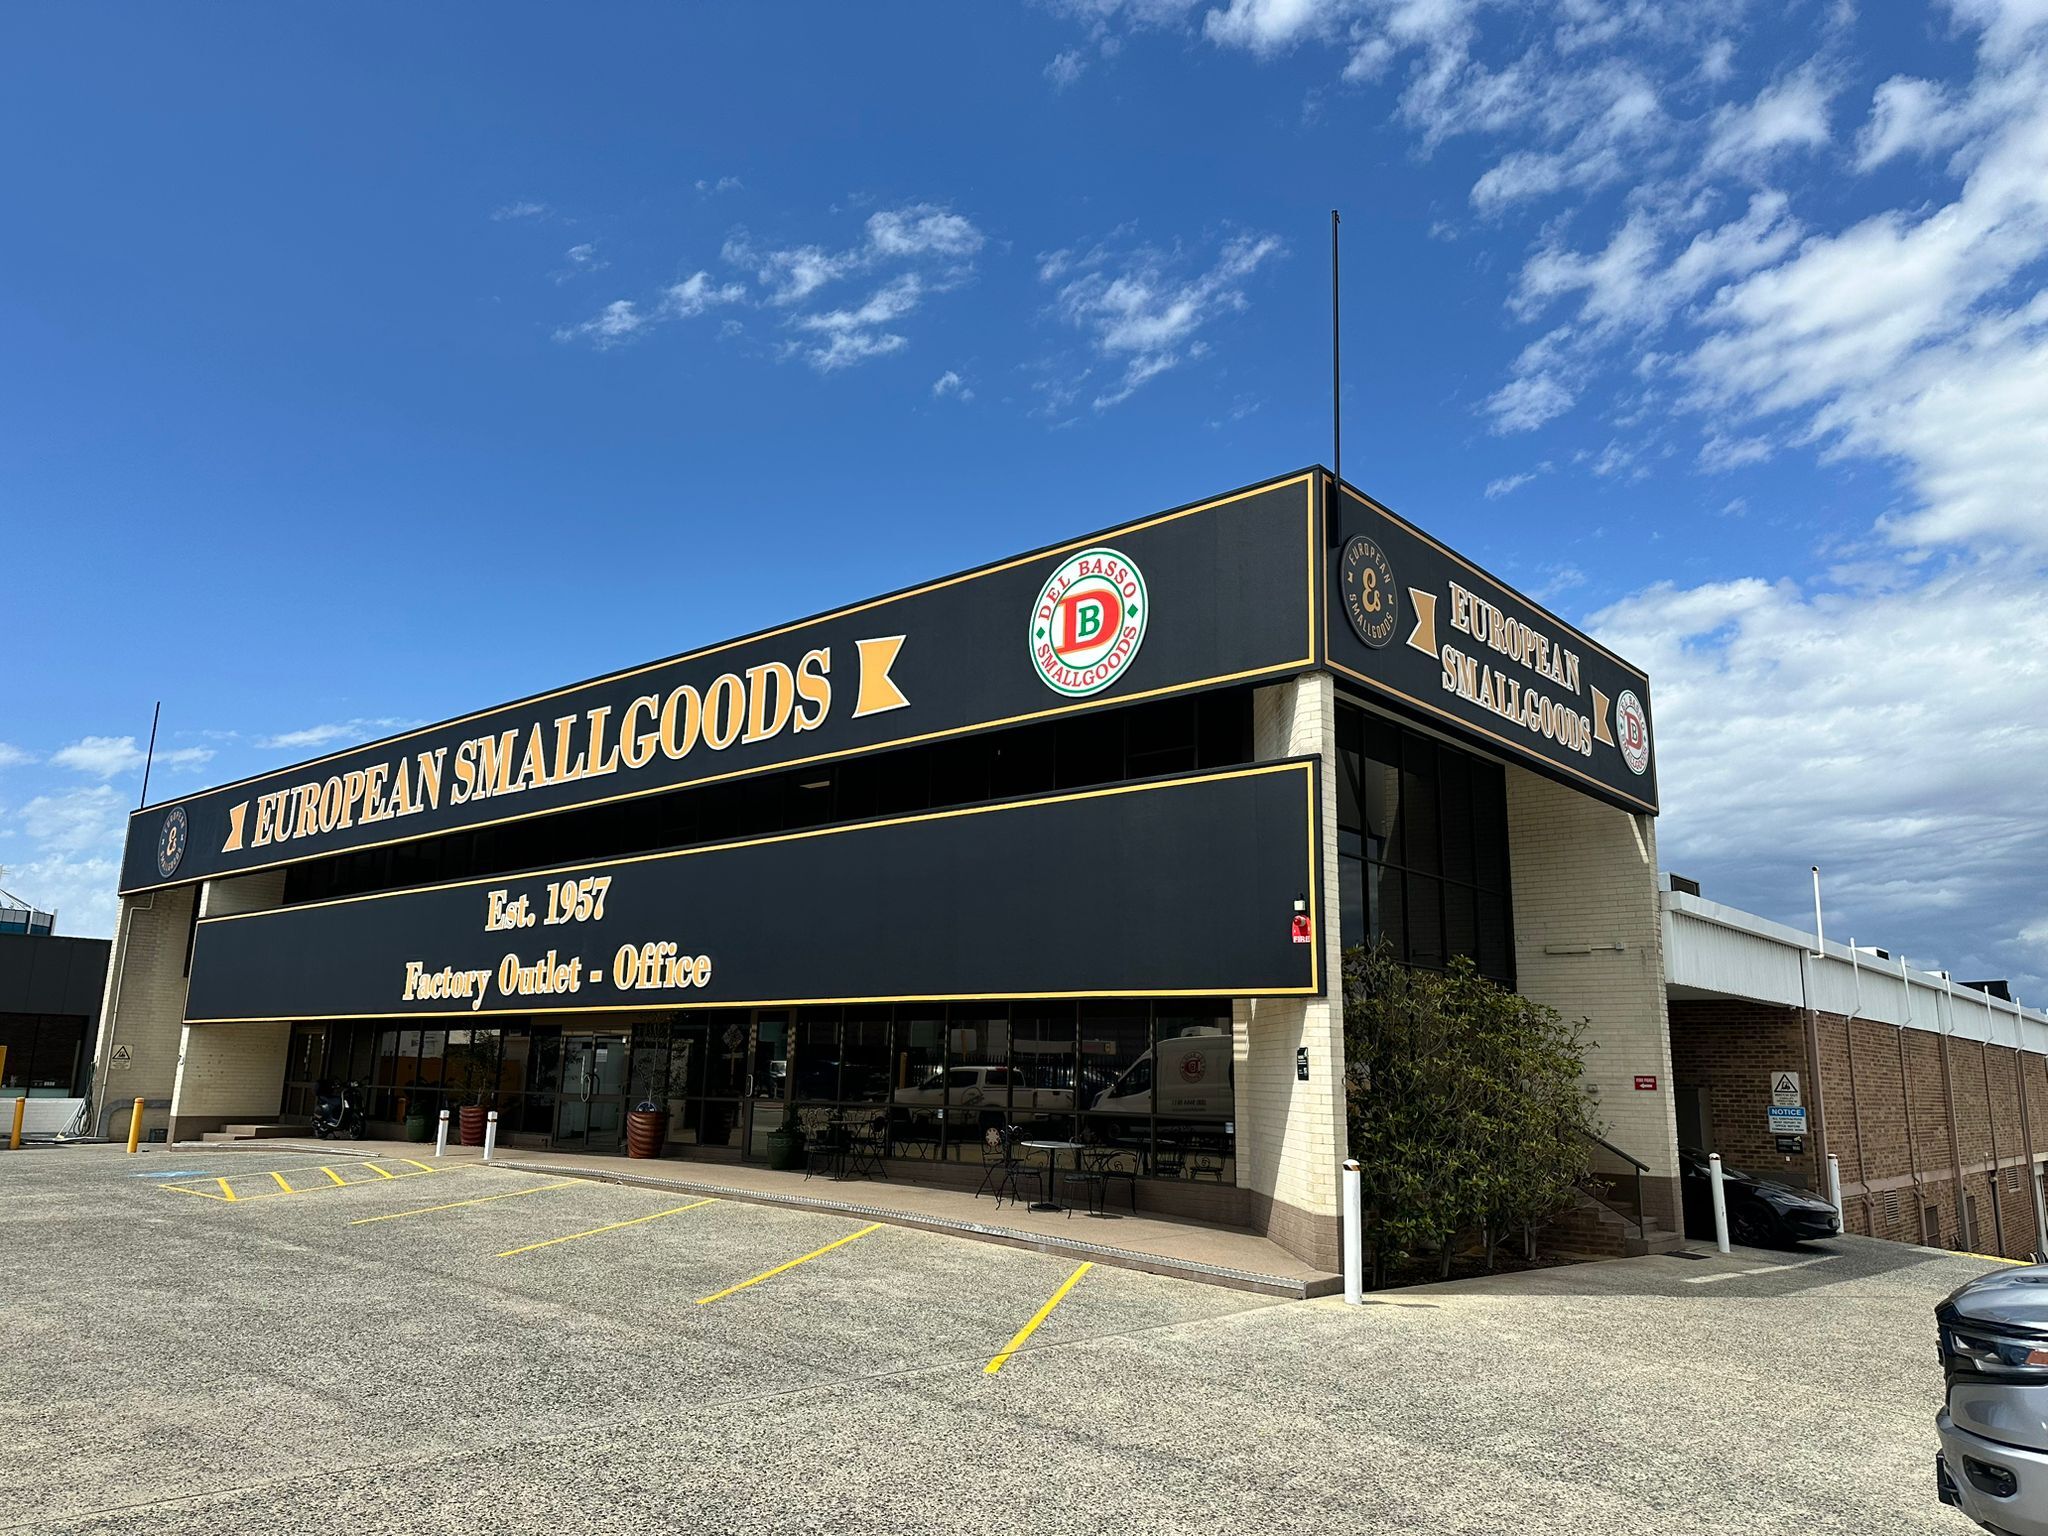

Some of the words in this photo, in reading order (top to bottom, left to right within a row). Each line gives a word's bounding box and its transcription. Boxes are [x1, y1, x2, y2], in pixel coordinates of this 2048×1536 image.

[1038, 576, 1071, 621] DEL
[1078, 558, 1137, 598] BASSO
[1348, 542, 1392, 584] EUROPEAN
[1349, 593, 1394, 639] SMALLGOODS
[1448, 580, 1581, 696] EUROPEAN
[1037, 626, 1137, 687] SMALLGOODS
[1441, 644, 1592, 757] SMALLGOODS
[251, 746, 448, 849] EUROPEAN
[450, 647, 832, 806] SMALLGOODS
[485, 889, 536, 931] Est.
[543, 876, 612, 925] 1957
[402, 961, 492, 1011] Factory
[498, 950, 581, 996] Outlet
[589, 969, 603, 983] -
[612, 941, 712, 990] Office
[1772, 1107, 1802, 1116] NOTICE
